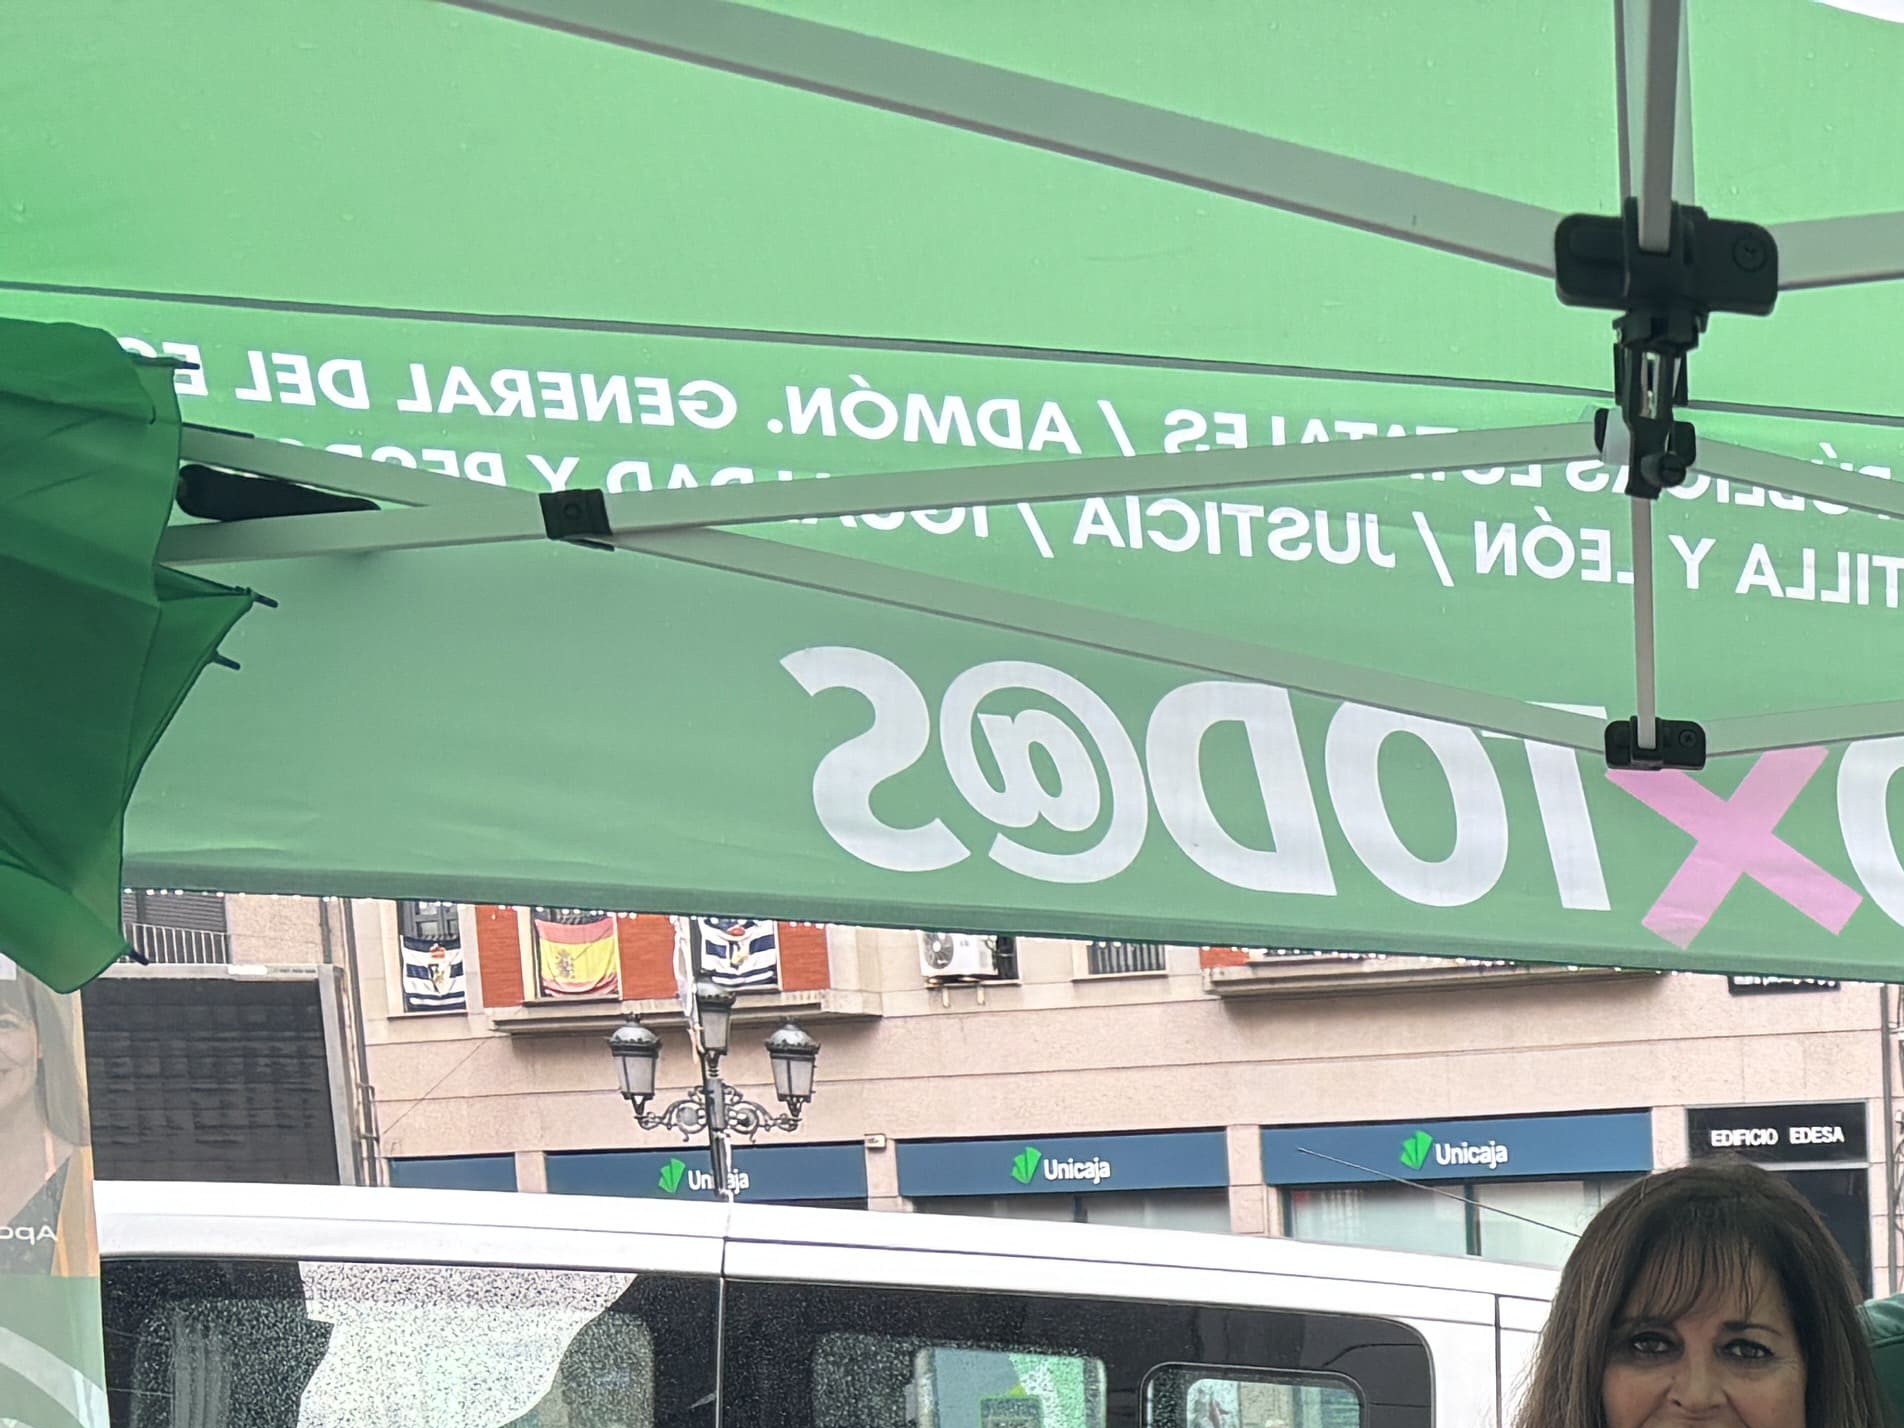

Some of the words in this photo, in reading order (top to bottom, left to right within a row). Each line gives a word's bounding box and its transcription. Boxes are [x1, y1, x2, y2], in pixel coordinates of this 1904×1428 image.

[1710, 1127, 1779, 1147] EDIFICIO
[1788, 1126, 1846, 1144] EDESA
[1042, 1154, 1112, 1186] Unicaja
[1434, 1138, 1510, 1170] Unicaja
